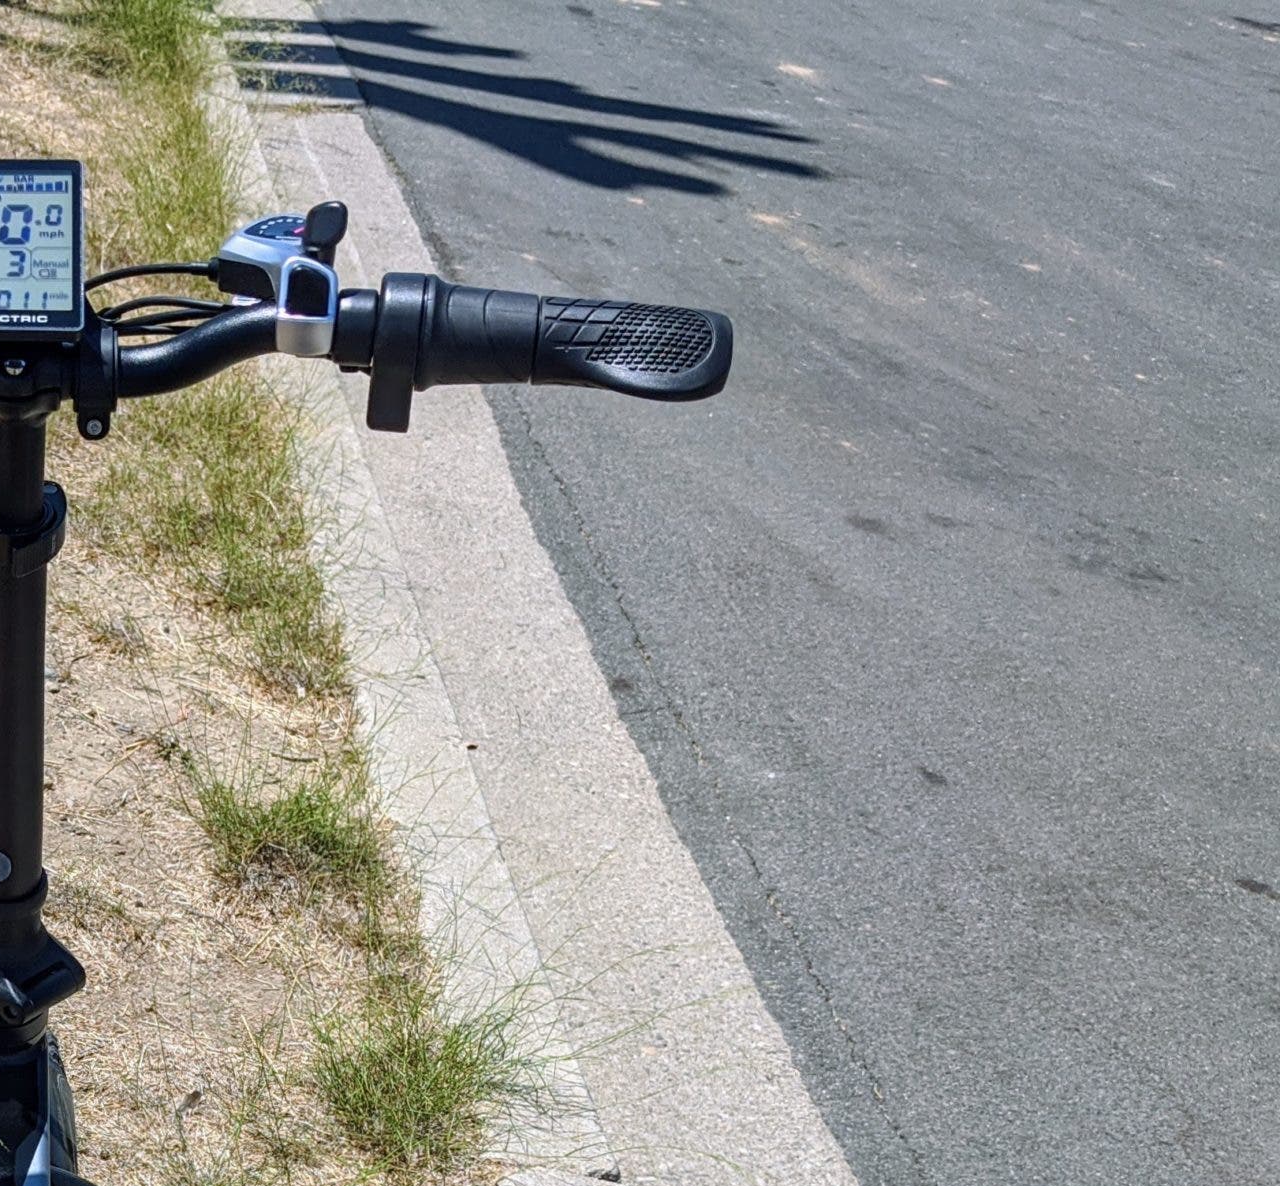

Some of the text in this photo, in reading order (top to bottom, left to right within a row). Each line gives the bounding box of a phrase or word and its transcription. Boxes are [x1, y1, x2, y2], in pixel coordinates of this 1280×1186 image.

[13, 175, 35, 183] BAR
[38, 229, 65, 239] mph
[6, 250, 26, 277] 3
[32, 259, 69, 269] Manual
